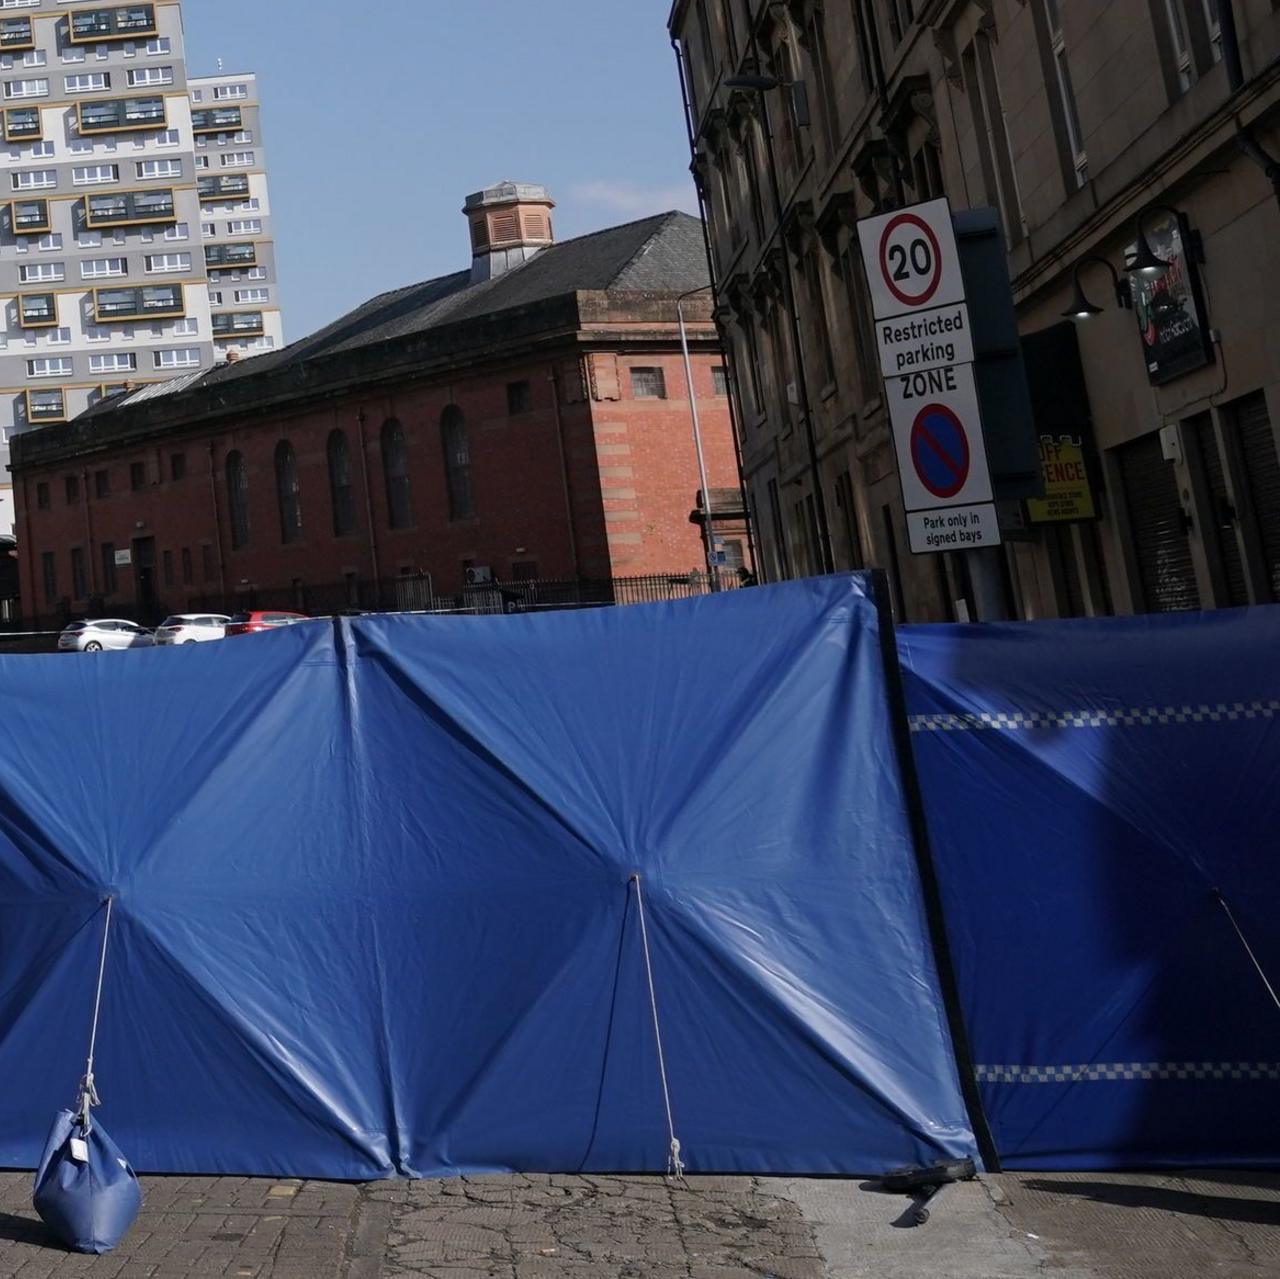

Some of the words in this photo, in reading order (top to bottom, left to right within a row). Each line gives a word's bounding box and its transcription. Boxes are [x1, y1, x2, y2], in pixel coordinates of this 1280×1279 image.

[889, 238, 931, 281] 20
[883, 311, 963, 344] Restricted
[896, 343, 955, 370] parking
[901, 367, 957, 399] ZONE
[923, 516, 945, 528] Park
[948, 514, 967, 527] only
[970, 512, 980, 524] in
[926, 531, 957, 546] signed
[959, 530, 982, 543] bays
